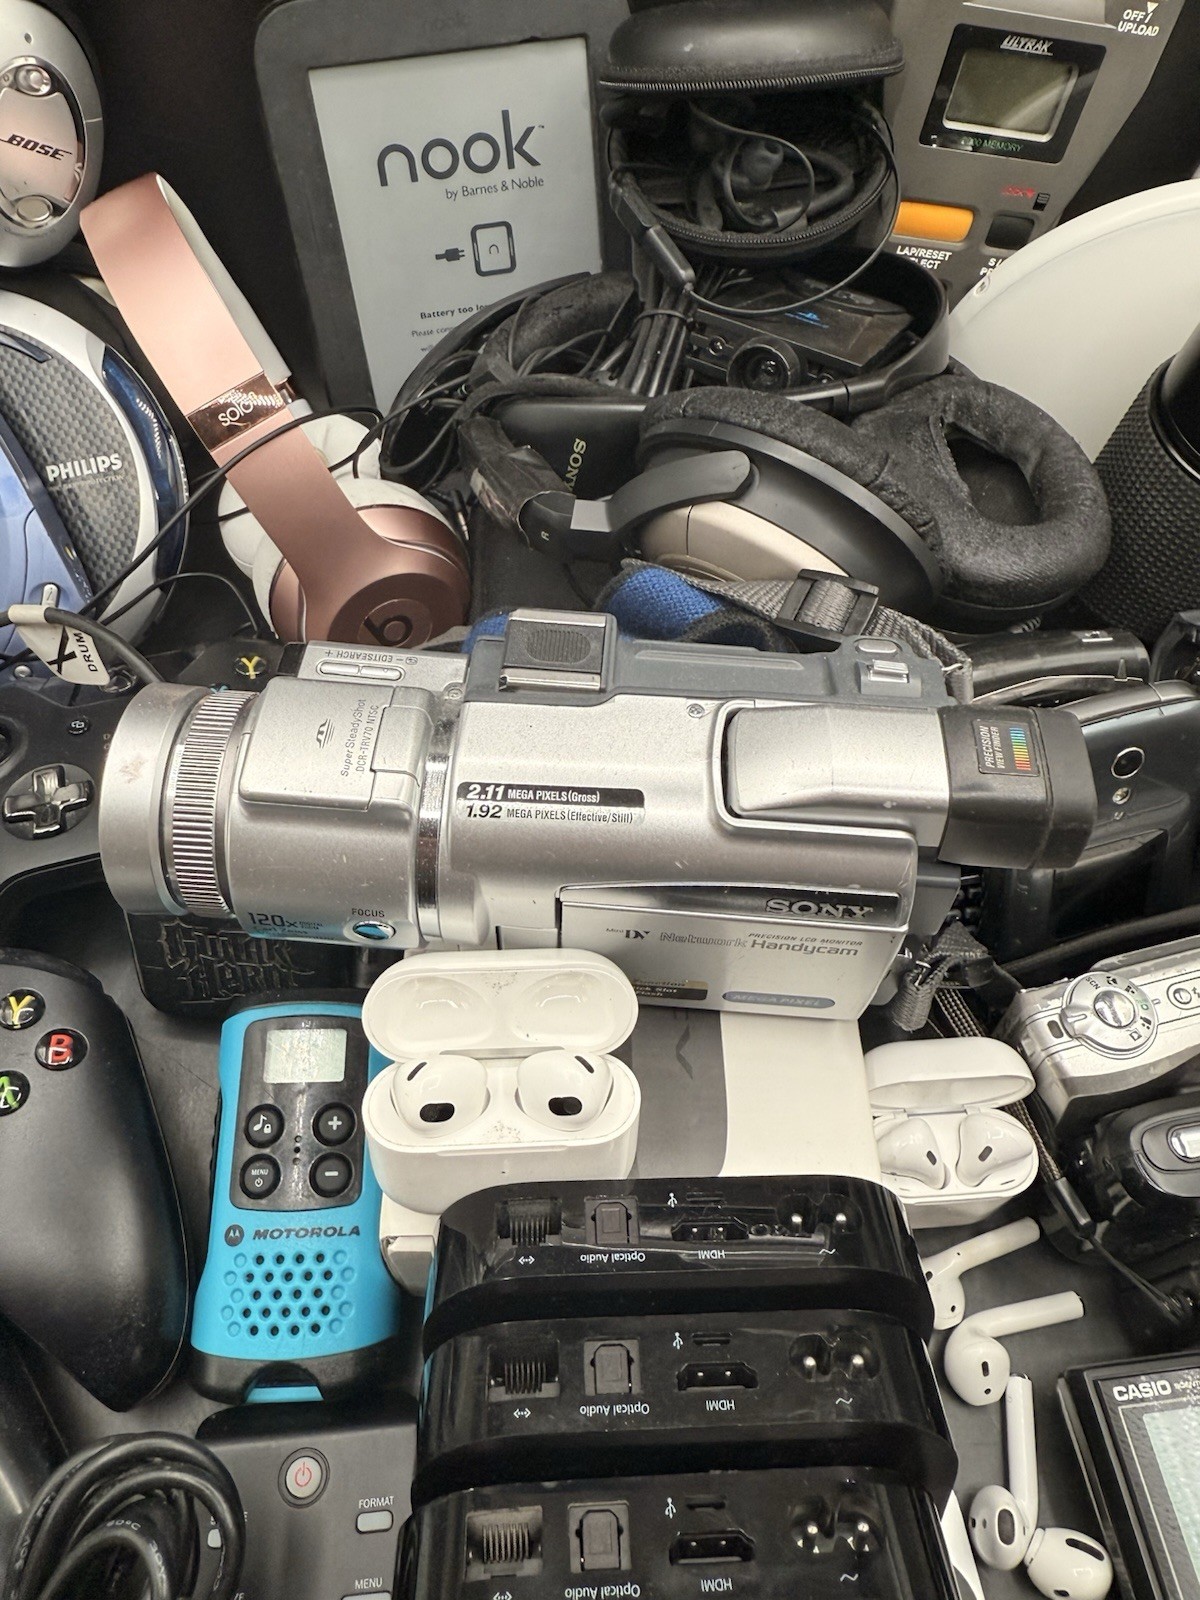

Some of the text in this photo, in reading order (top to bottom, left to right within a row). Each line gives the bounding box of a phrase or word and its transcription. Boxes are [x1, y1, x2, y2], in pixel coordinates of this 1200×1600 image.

[1117, 21, 1160, 37] UPLOAD
[5, 133, 73, 161] BOSE
[376, 109, 541, 187] nook
[983, 139, 1023, 152] MEMORY
[445, 175, 544, 201] by Barnes & Noble
[896, 245, 952, 261] LAP/RESET
[420, 308, 455, 320] Battery
[458, 305, 474, 314] too
[45, 452, 123, 483] PHILIPS
[564, 438, 587, 492] SONY
[540, 530, 550, 541] R
[73, 632, 99, 672] DRUM
[335, 651, 394, 663] EDITSEARCH
[240, 655, 262, 680] Y
[340, 699, 367, 777] Super SteadyShot
[978, 725, 996, 768] PRECISION
[355, 726, 375, 773] DCR-TRV70
[989, 726, 1006, 769] VIEW FINDER
[466, 783, 505, 801] 2.11
[507, 788, 534, 800] MEGA
[466, 804, 503, 819] 1.92
[506, 808, 533, 820] MEGA
[351, 907, 385, 918] FOCUS
[765, 897, 874, 920] SONY
[247, 911, 298, 928] 120x
[625, 929, 651, 940] DV
[660, 931, 748, 949] Network
[748, 932, 798, 942] PRECISION
[819, 938, 864, 947] MONITOR
[750, 939, 859, 956] Handycam
[1085, 976, 1101, 990] SCN
[8, 995, 36, 1029] Y
[47, 1033, 74, 1065] B
[251, 1168, 269, 1177] MENU
[252, 1225, 361, 1241] MOTOROLA
[580, 1251, 646, 1264] Optical Audio
[698, 1249, 726, 1260] HDMI
[1112, 1379, 1172, 1402] CASIO
[579, 1401, 650, 1418] Optical Audio
[705, 1399, 735, 1411] HDMI
[358, 1495, 395, 1509] FORMAT
[354, 1577, 383, 1590] MENU
[564, 1581, 641, 1600] Optical Audio
[700, 1577, 733, 1593] HDMI
